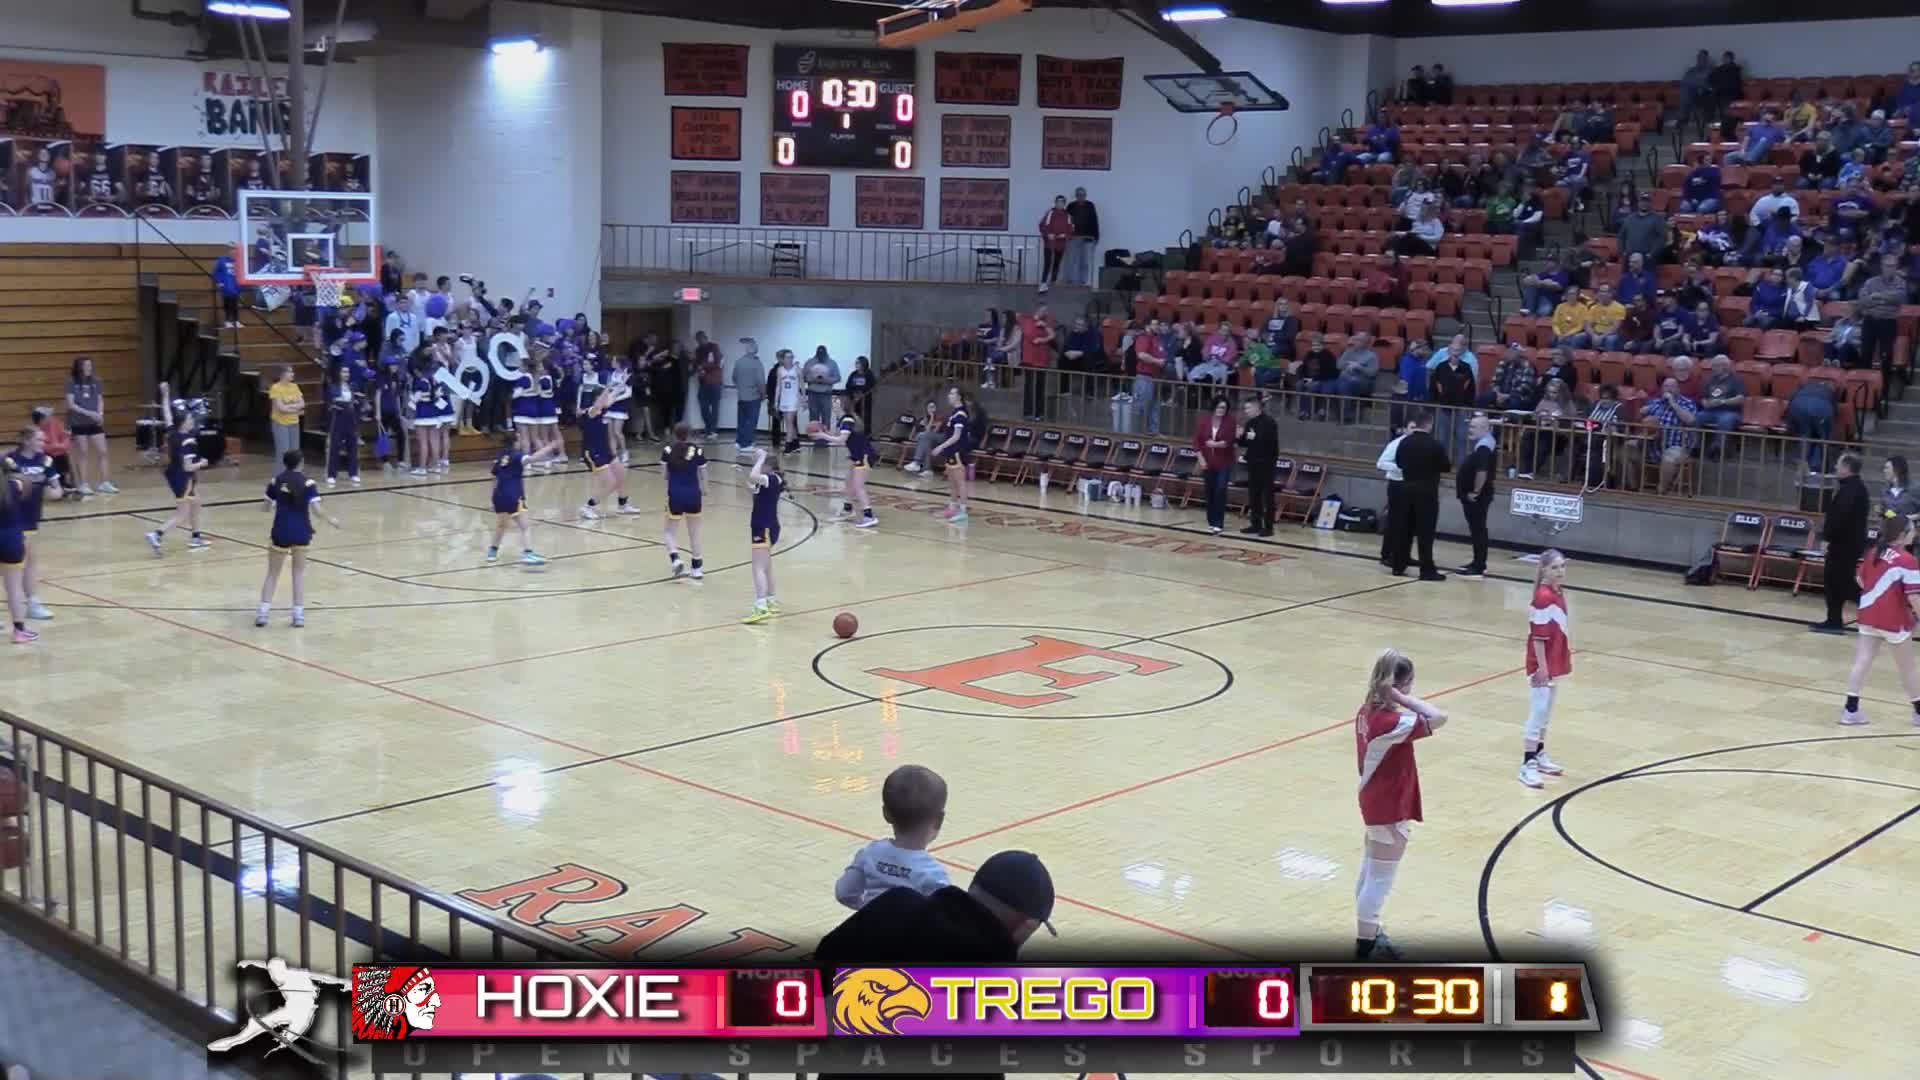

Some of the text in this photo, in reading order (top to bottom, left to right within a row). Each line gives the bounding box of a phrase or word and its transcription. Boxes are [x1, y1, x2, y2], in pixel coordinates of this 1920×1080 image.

[776, 80, 809, 91] HOME
[879, 83, 914, 93] GUEST
[791, 90, 809, 118] 0
[896, 94, 913, 121] 0
[843, 113, 850, 129] 1
[778, 137, 795, 165] 0
[895, 141, 912, 168] 0
[1516, 493, 1579, 508] STAY OFF COURT
[1525, 503, 1551, 513] STREET
[1735, 515, 1760, 525] ELLIS
[1780, 518, 1805, 529] ELLIS
[864, 635, 1182, 708] E
